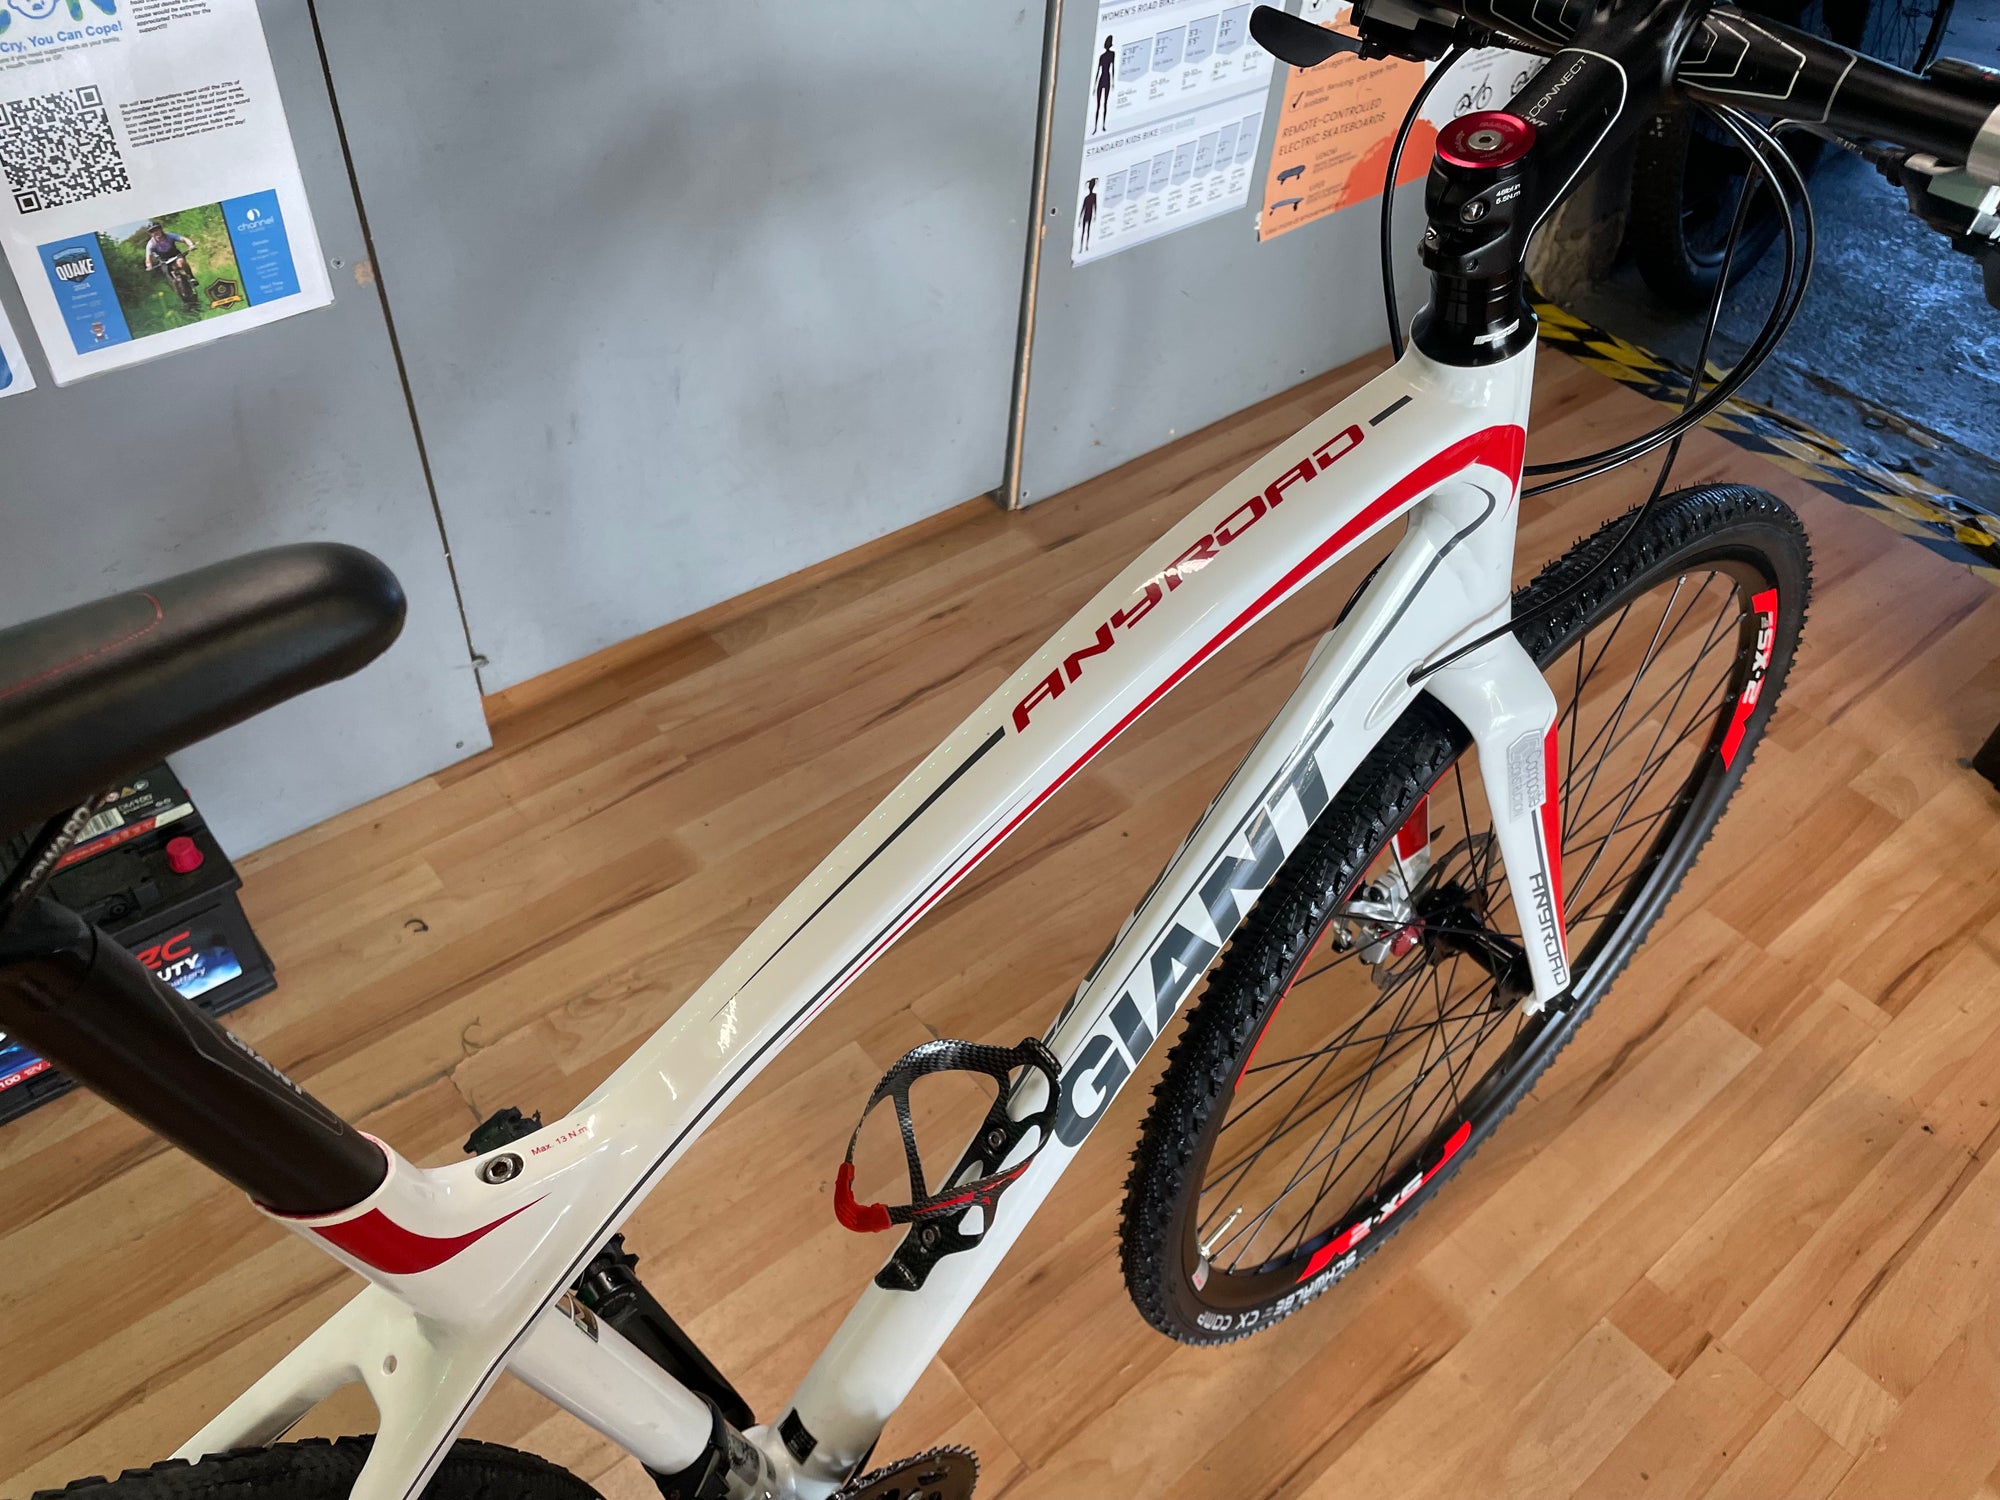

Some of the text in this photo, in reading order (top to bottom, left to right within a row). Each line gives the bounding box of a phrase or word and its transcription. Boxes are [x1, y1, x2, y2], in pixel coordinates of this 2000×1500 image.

[1101, 5, 1136, 22] WOMEN'S
[28, 35, 54, 47] You
[57, 29, 83, 42] Can
[85, 20, 123, 37] Cope!
[1529, 55, 1588, 118] CONNECT
[1281, 98, 1383, 138] REMOTE-CONTROLLED
[1086, 138, 1124, 157] STANDARD
[1126, 132, 1141, 145] KIDS
[1143, 128, 1159, 140] BIKE
[1278, 112, 1387, 156] ELECTRIC SKATEBOARDS
[238, 216, 275, 232] channel
[55, 258, 95, 281] QUAKE
[1054, 718, 1334, 1148] GIANT
[530, 1144, 553, 1156] Max.
[555, 1135, 568, 1145] 13
[1272, 1249, 1357, 1319] SCHWALBE
[1196, 1310, 1233, 1332] COMP
[1235, 1308, 1260, 1330] CX
